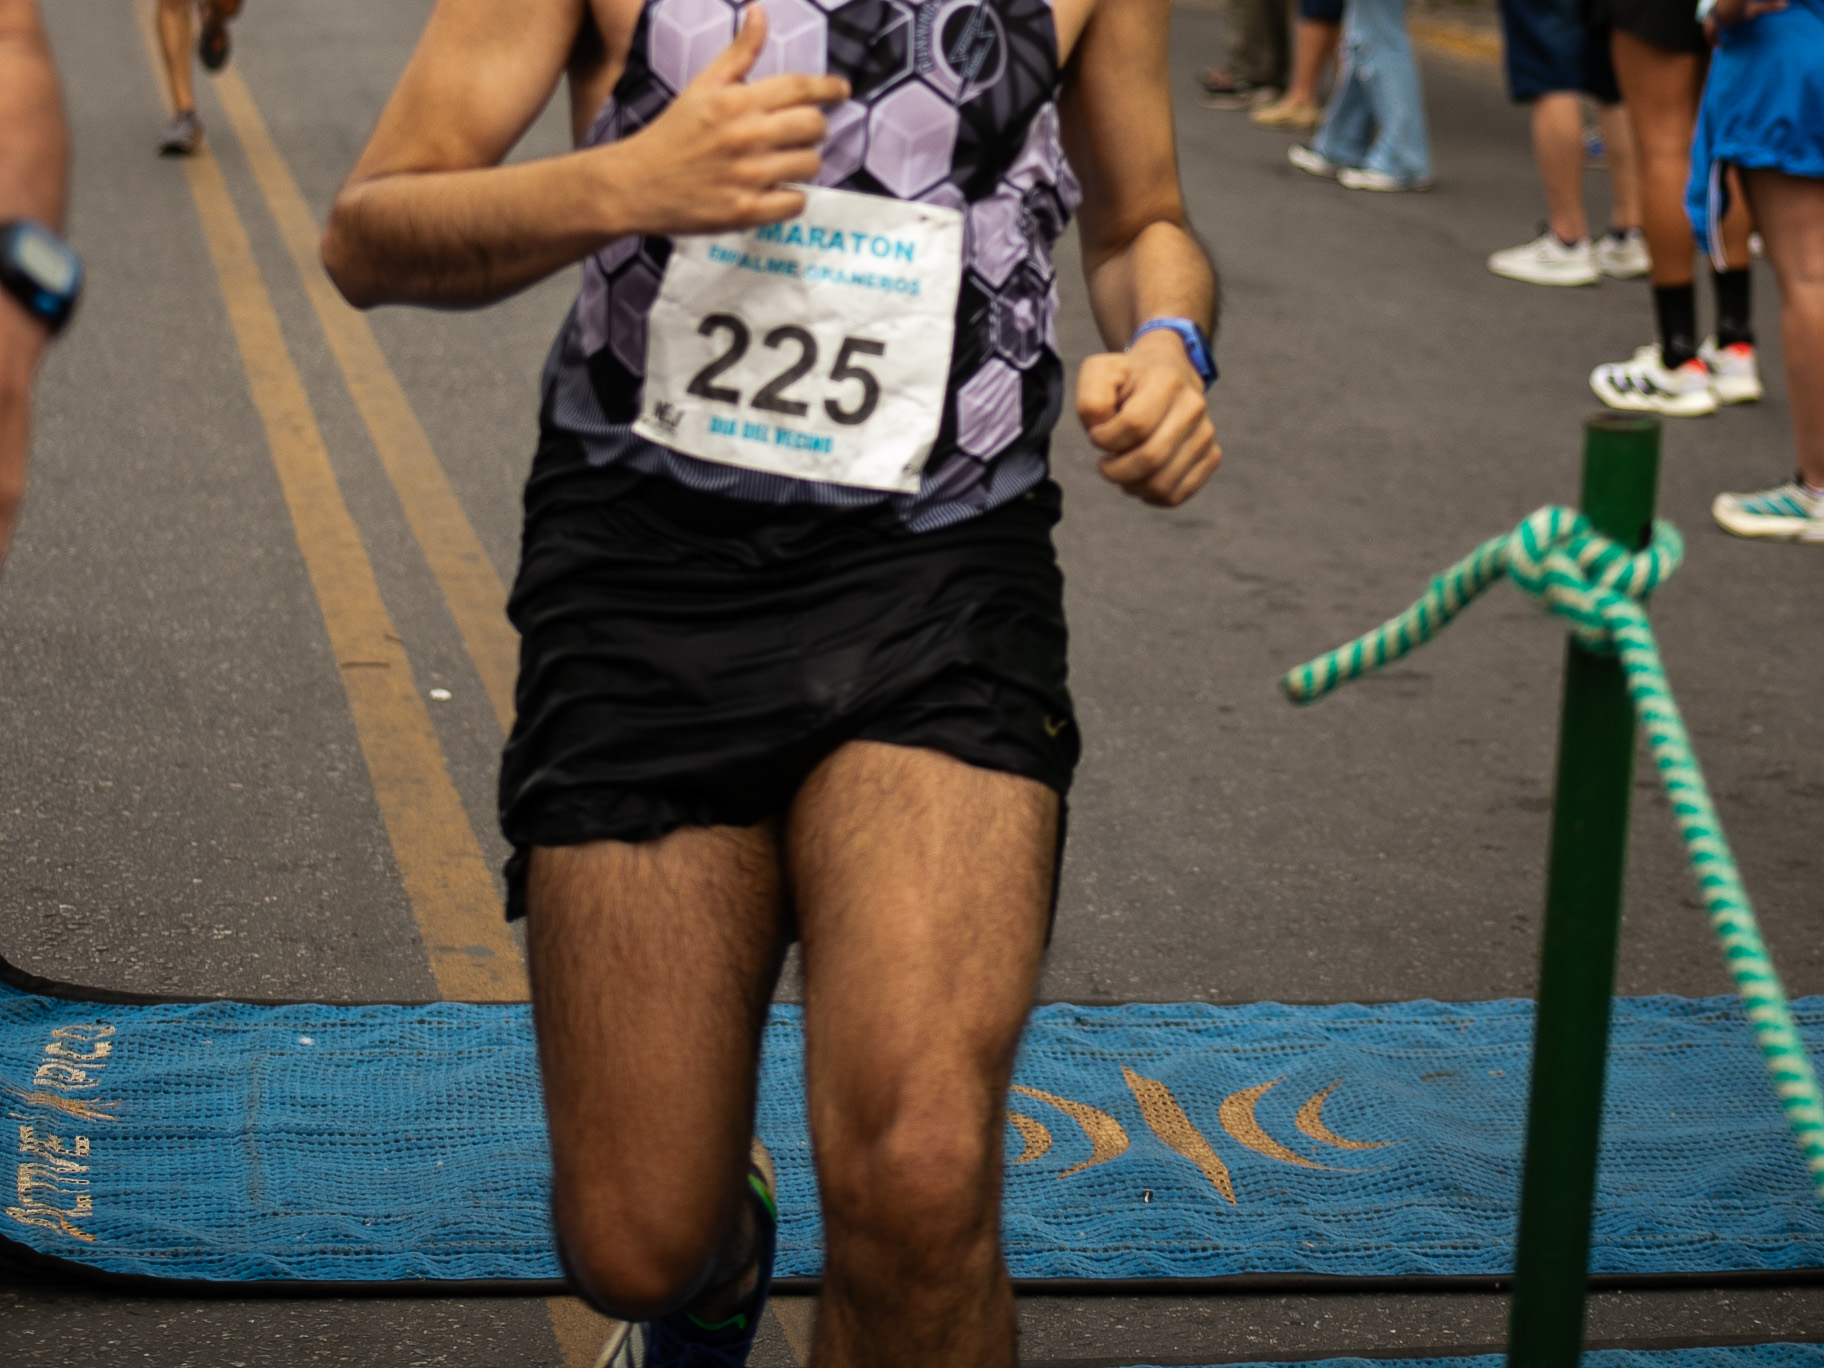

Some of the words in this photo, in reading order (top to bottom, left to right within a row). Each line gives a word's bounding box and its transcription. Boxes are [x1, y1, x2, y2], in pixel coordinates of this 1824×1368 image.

[756, 219, 916, 262] MARATON
[686, 313, 886, 425] 225
[742, 423, 769, 441] DEL
[5, 1125, 97, 1243] ACTIVE
